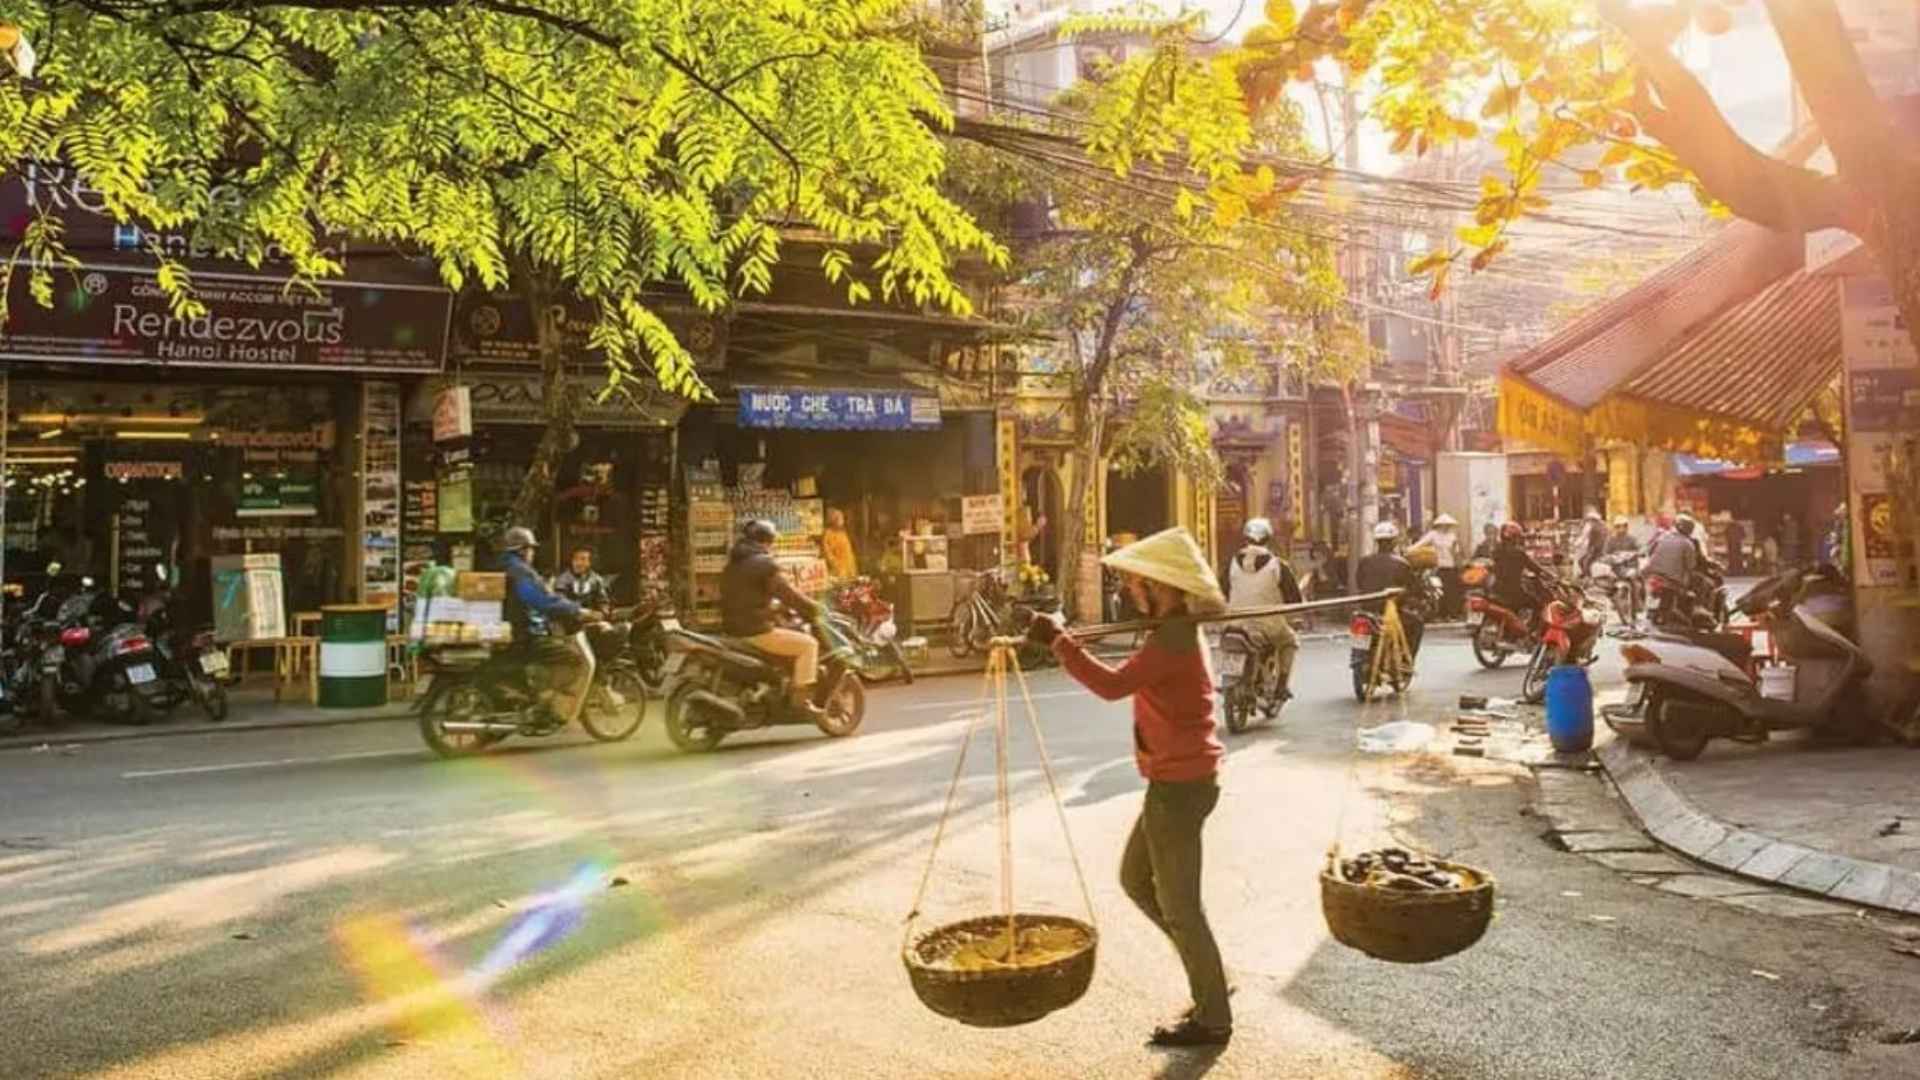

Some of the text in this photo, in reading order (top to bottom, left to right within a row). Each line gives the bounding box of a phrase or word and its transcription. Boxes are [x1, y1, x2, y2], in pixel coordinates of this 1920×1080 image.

[113, 304, 343, 345] Rendezvous
[157, 340, 221, 360] Hanoi
[228, 342, 297, 363] Hostel
